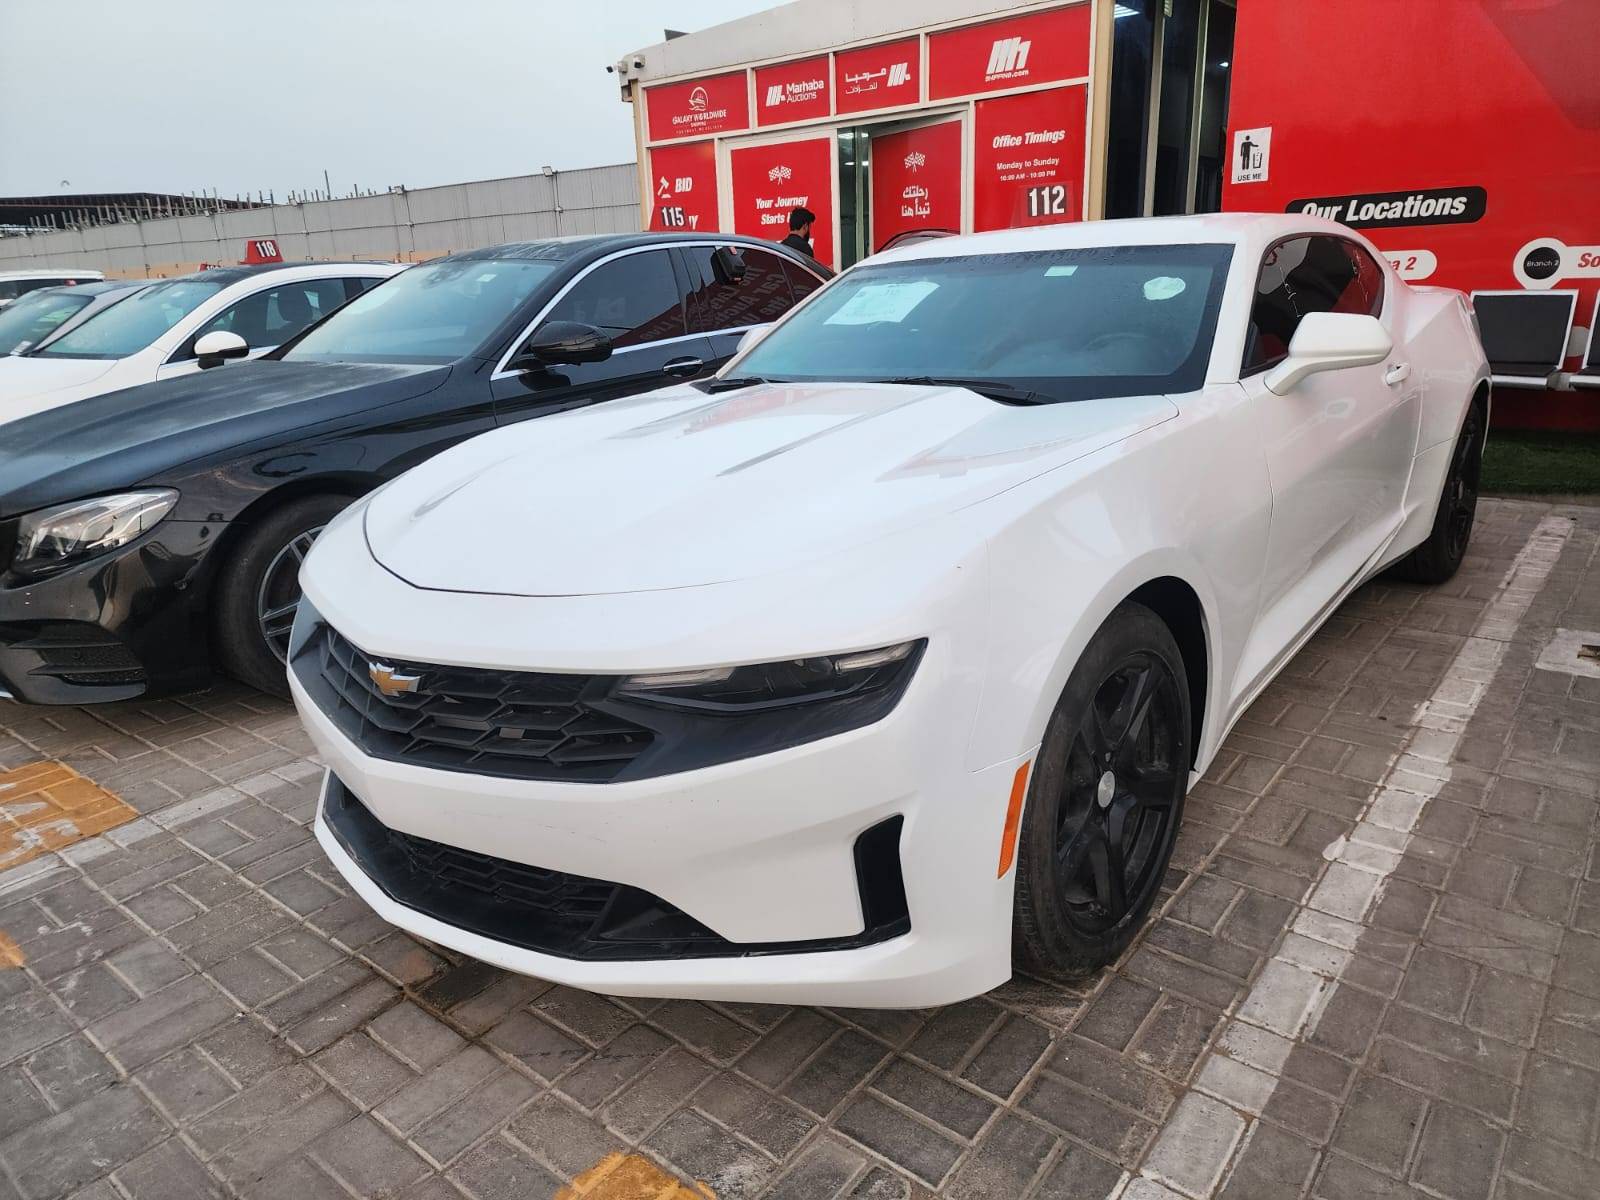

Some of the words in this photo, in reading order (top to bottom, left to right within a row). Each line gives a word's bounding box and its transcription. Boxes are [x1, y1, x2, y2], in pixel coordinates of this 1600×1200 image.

[786, 79, 825, 95] Marhaba
[786, 91, 817, 104] Auctions
[672, 114, 693, 125] GALAXY
[693, 109, 727, 122] WORLDWIDE
[992, 134, 1023, 149] Office
[1024, 129, 1066, 145] Timings
[996, 160, 1024, 171] Monday
[1024, 160, 1032, 168] to
[1033, 157, 1060, 167] Sunday
[1015, 172, 1026, 181] AM
[1046, 169, 1057, 177] PM
[1237, 174, 1251, 182] USE
[1252, 172, 1262, 180] ME
[675, 176, 693, 193] BID
[903, 185, 928, 200] رحلتك
[756, 197, 774, 209] Your
[774, 195, 808, 208] Journey
[915, 197, 931, 219] تبدأ
[1028, 185, 1066, 217] 112
[1345, 194, 1468, 222] Locations
[662, 206, 685, 227] 115
[761, 212, 786, 225] Starts
[901, 204, 914, 218] هنا
[256, 241, 277, 258] 118
[1404, 256, 1417, 271] 2
